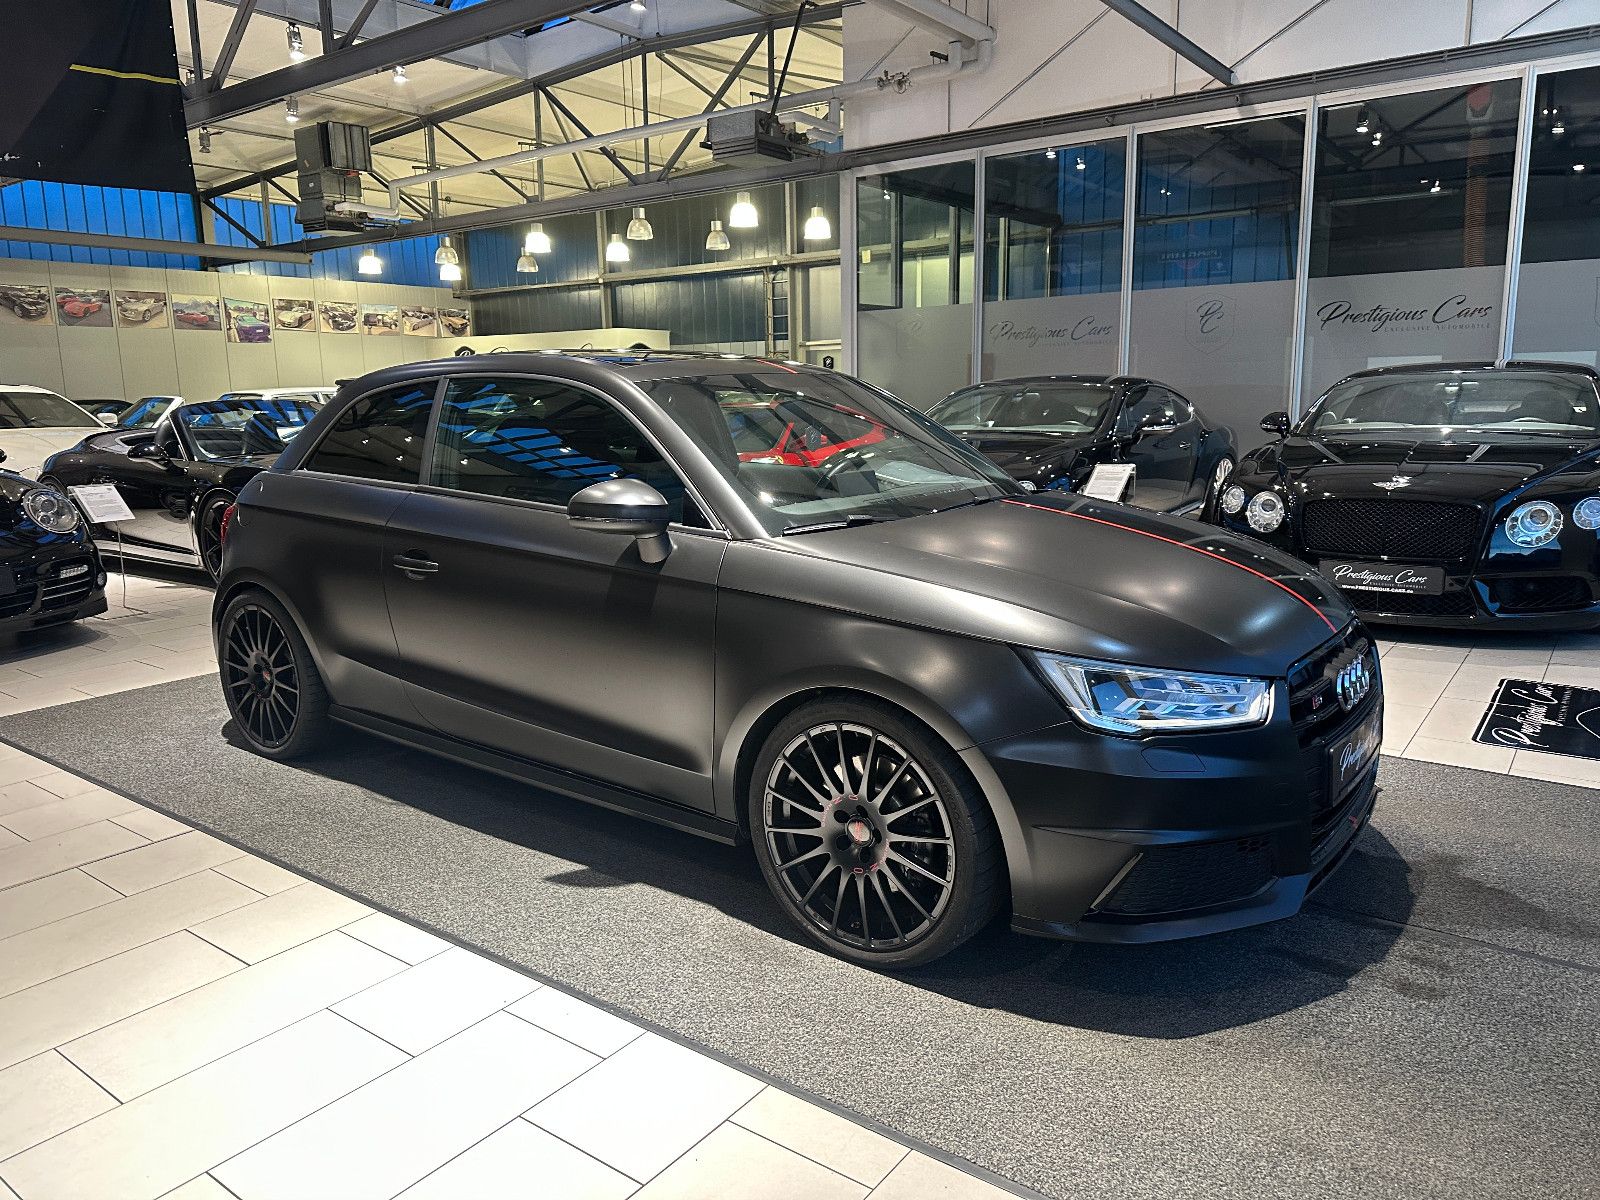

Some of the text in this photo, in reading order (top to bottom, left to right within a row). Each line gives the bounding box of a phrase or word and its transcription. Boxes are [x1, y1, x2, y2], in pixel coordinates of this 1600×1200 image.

[1316, 294, 1492, 332] Prestigious Cars
[1070, 315, 1113, 341] Cars
[1332, 564, 1428, 584] Prestigious Cars
